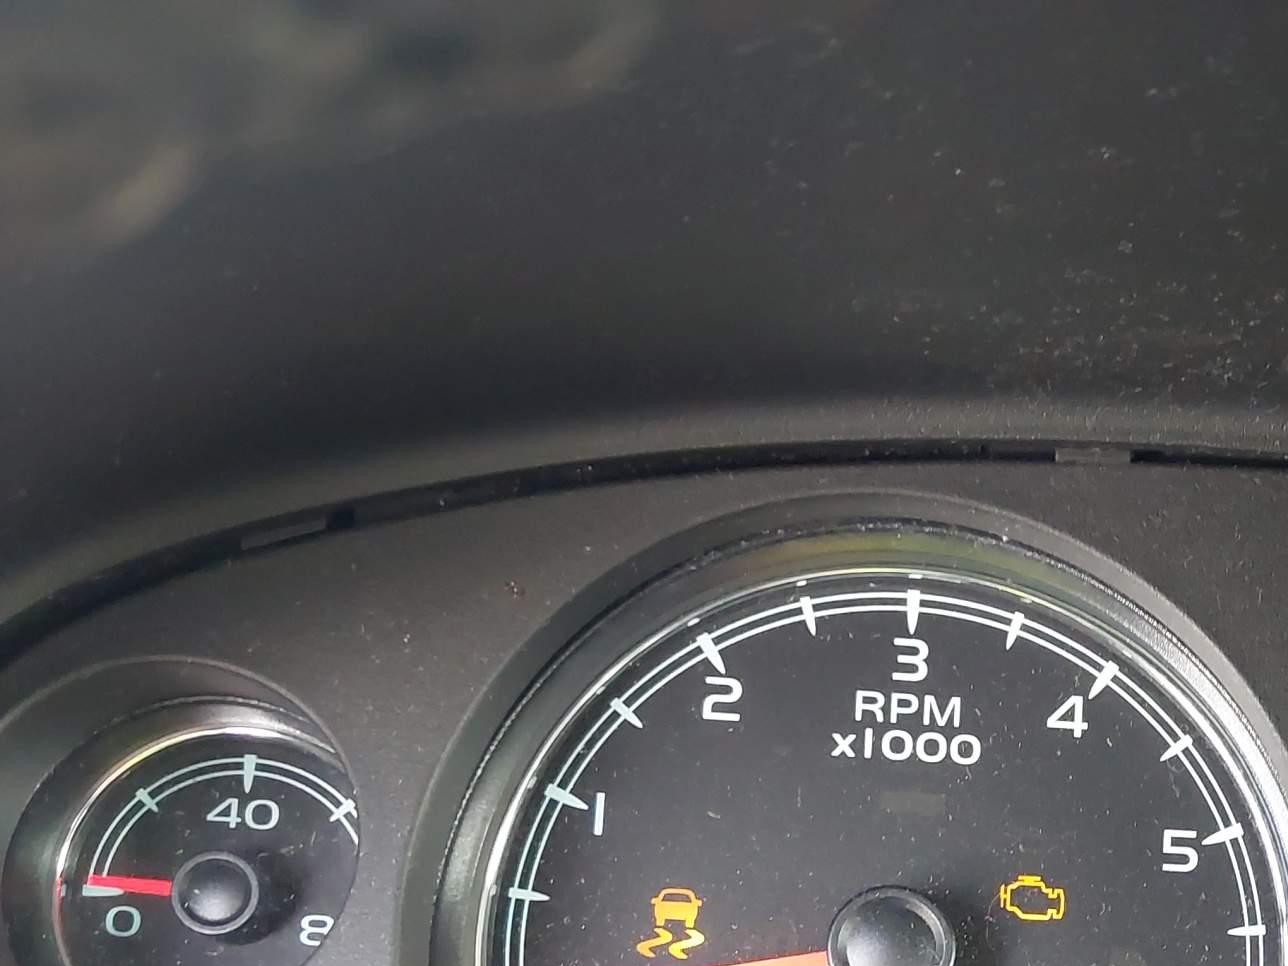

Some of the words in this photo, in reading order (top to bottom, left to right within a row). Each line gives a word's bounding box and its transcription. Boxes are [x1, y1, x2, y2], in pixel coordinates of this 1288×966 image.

[892, 637, 929, 683] 3
[701, 676, 742, 723] 2
[853, 689, 962, 726] RPM
[1046, 698, 1089, 739] 4
[830, 730, 982, 766] x1000
[205, 797, 281, 831] 40
[594, 792, 606, 836] 1
[1161, 829, 1199, 873] 5
[105, 905, 142, 938] 0
